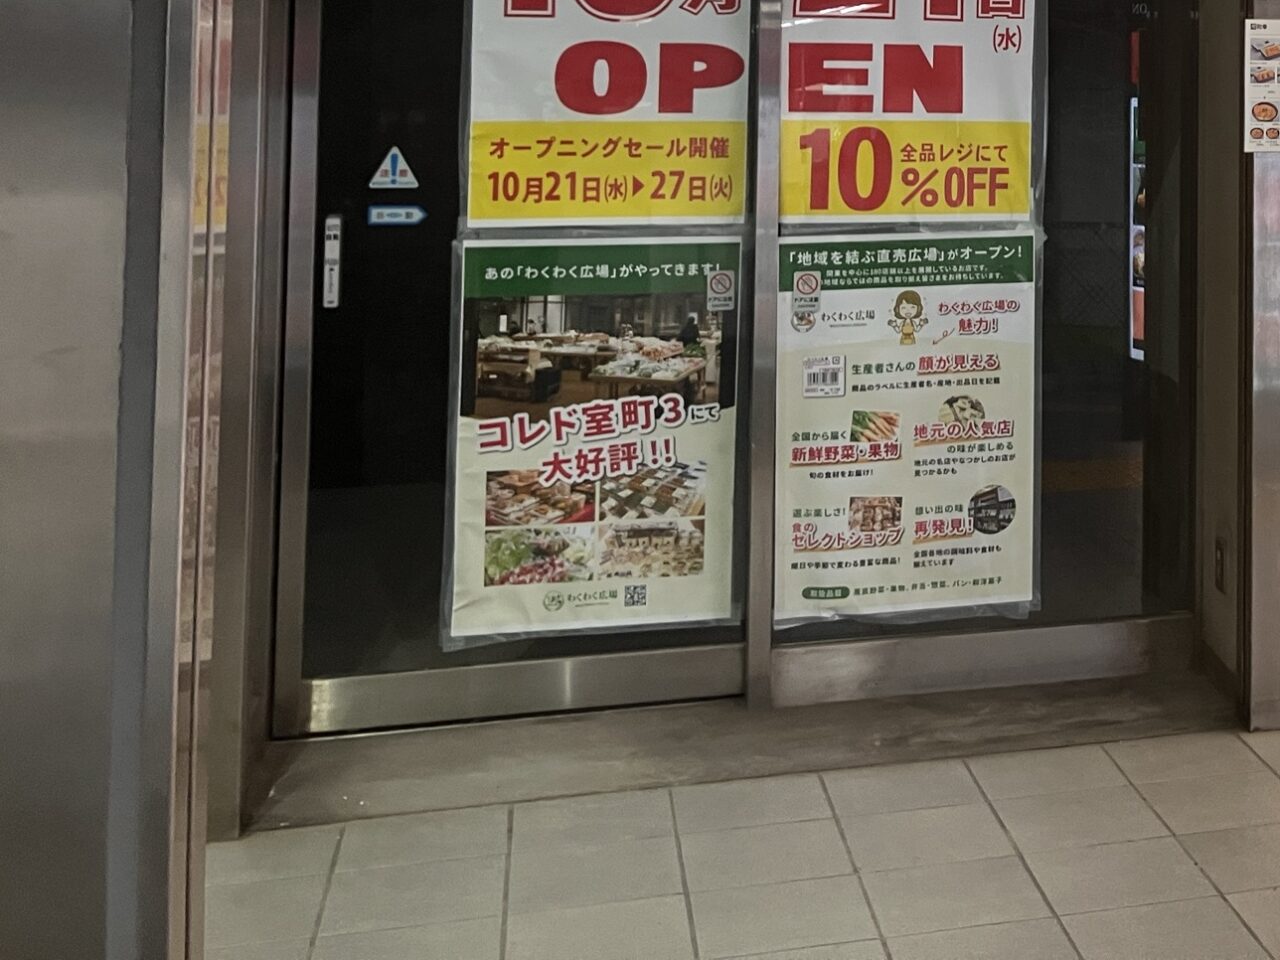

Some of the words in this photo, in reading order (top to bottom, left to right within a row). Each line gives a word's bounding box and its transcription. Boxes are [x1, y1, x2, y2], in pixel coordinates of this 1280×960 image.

[992, 26, 1022, 53] (水)
[489, 136, 729, 158] オープニングセール開催
[900, 143, 1008, 162] 全品レジにて
[789, 245, 1022, 266] 「地域を結ぶ直売広場」がオープン!
[822, 309, 876, 322] わくわく広場
[938, 300, 1020, 316] わくわく広場の
[958, 318, 999, 334] 魅力!
[791, 431, 847, 441] 全国から届く
[913, 421, 1013, 440] 地元の人気店
[947, 442, 1014, 453] の味が楽しめる
[541, 437, 674, 484] 大好評!!
